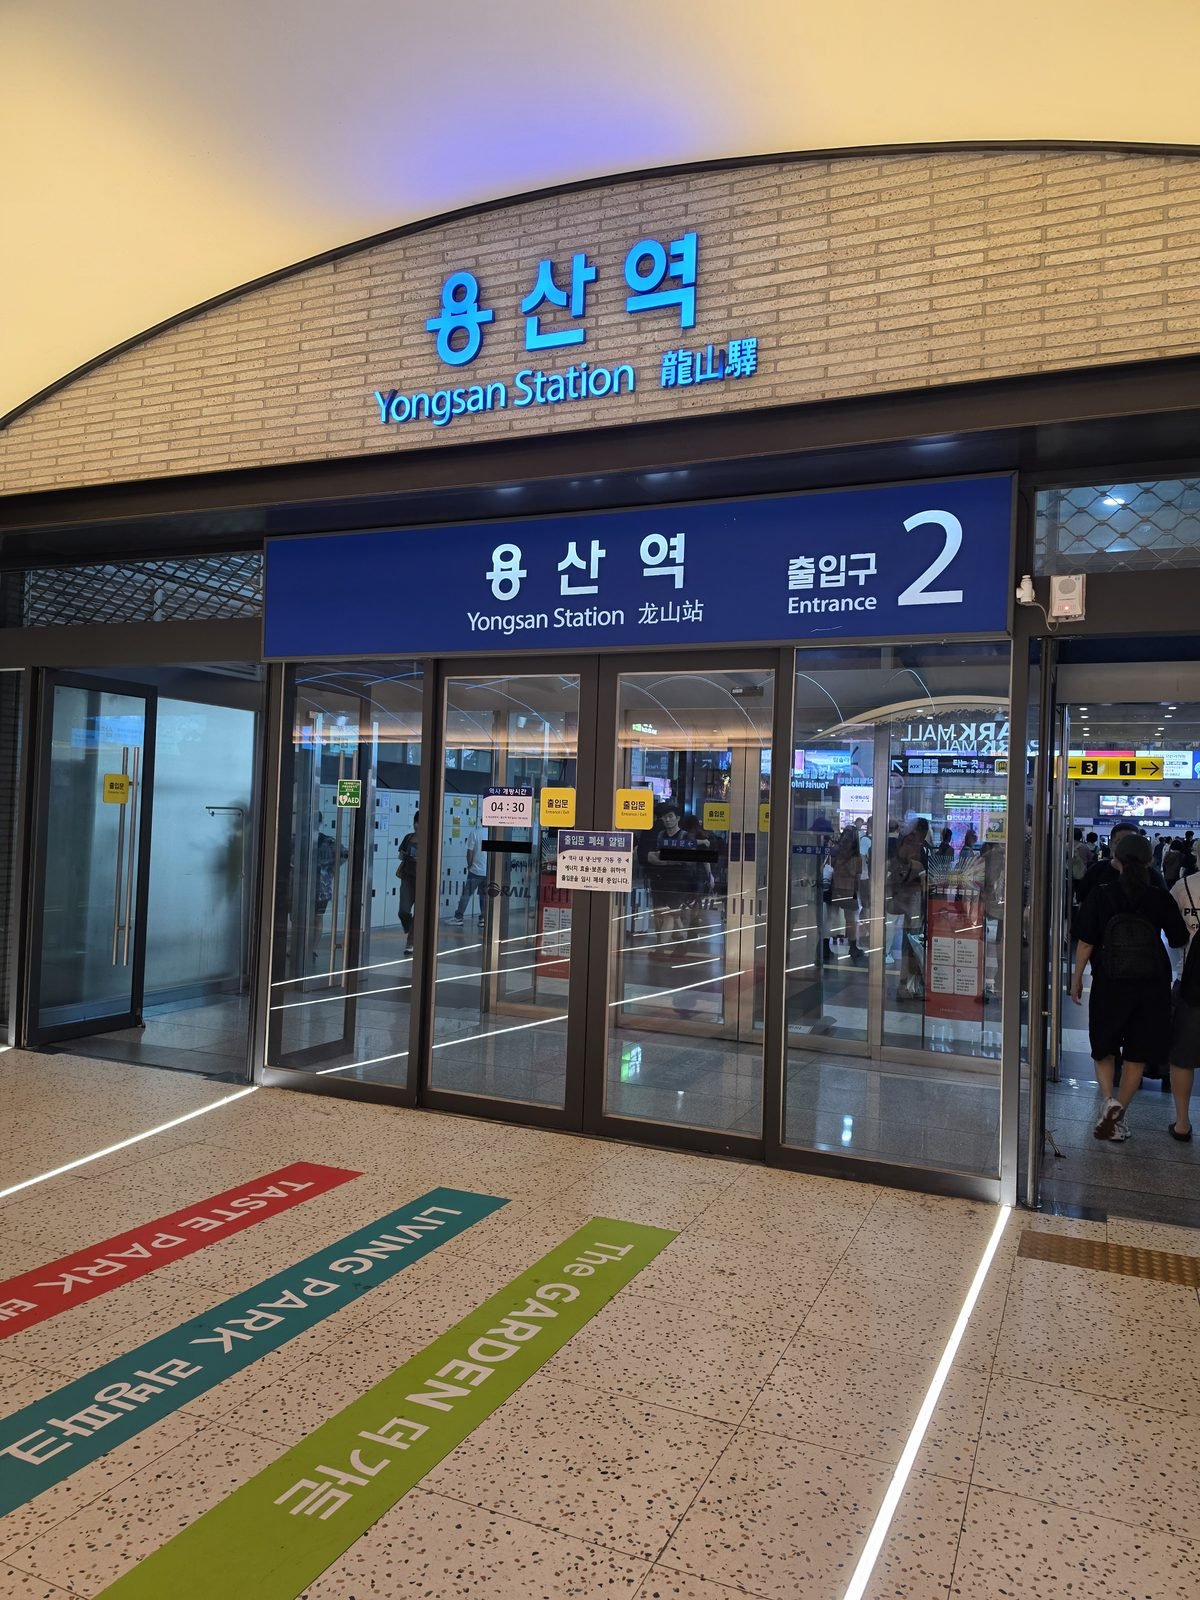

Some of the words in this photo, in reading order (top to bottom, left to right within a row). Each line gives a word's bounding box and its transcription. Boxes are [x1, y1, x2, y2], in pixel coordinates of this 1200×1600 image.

[374, 381, 506, 426] Yongsan
[513, 361, 635, 407] Station
[661, 337, 758, 388] 龍山驛
[787, 552, 877, 591] 출입구
[897, 509, 963, 607] 2
[467, 610, 548, 635] Yongsan
[553, 605, 624, 628] Station
[637, 599, 704, 625] 龙山站
[788, 595, 877, 615] Entrance
[1086, 763, 1093, 773] 3
[1125, 763, 1131, 773] 1
[547, 799, 568, 808] 출입문
[623, 800, 646, 811] 출입문
[564, 834, 585, 846] 출입문
[608, 837, 625, 847] 알림
[177, 1179, 315, 1234] TASTE
[33, 1232, 188, 1295] PARK
[328, 1205, 463, 1276] LIVING
[562, 1240, 634, 1279] The
[188, 1276, 341, 1354] PARK
[404, 1282, 581, 1413] GARDEN
[0, 1358, 204, 1466] 리빙파크
